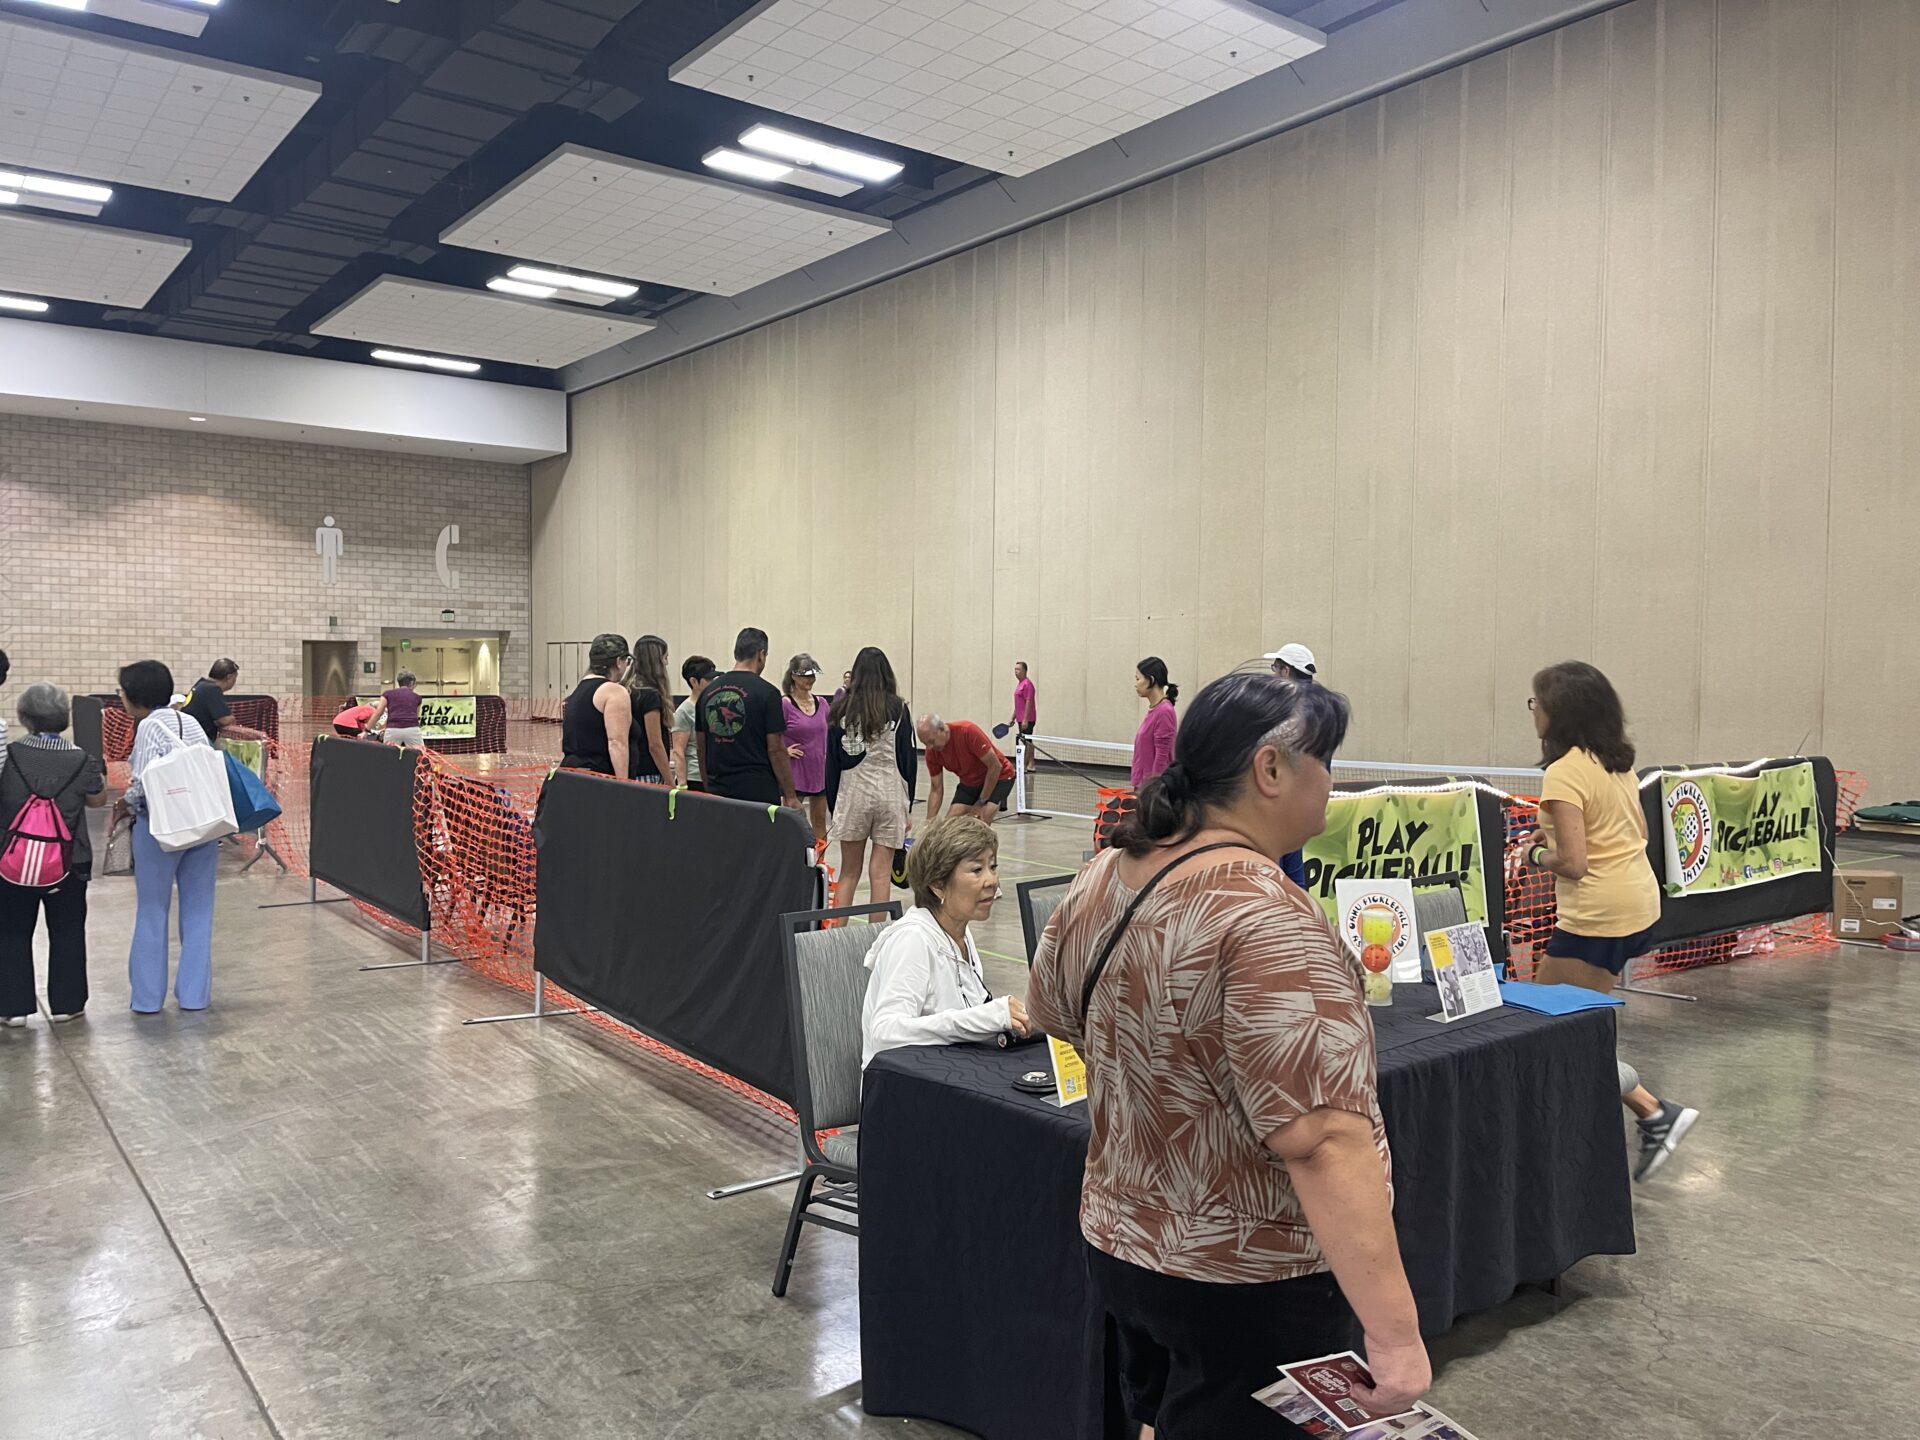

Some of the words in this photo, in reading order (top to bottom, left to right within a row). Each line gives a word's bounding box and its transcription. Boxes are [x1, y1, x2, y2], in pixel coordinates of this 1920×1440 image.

[419, 713, 474, 727] KLEBALL!
[421, 705, 452, 716] PLAY
[1752, 791, 1780, 819] AY
[1356, 817, 1428, 859] PLAY
